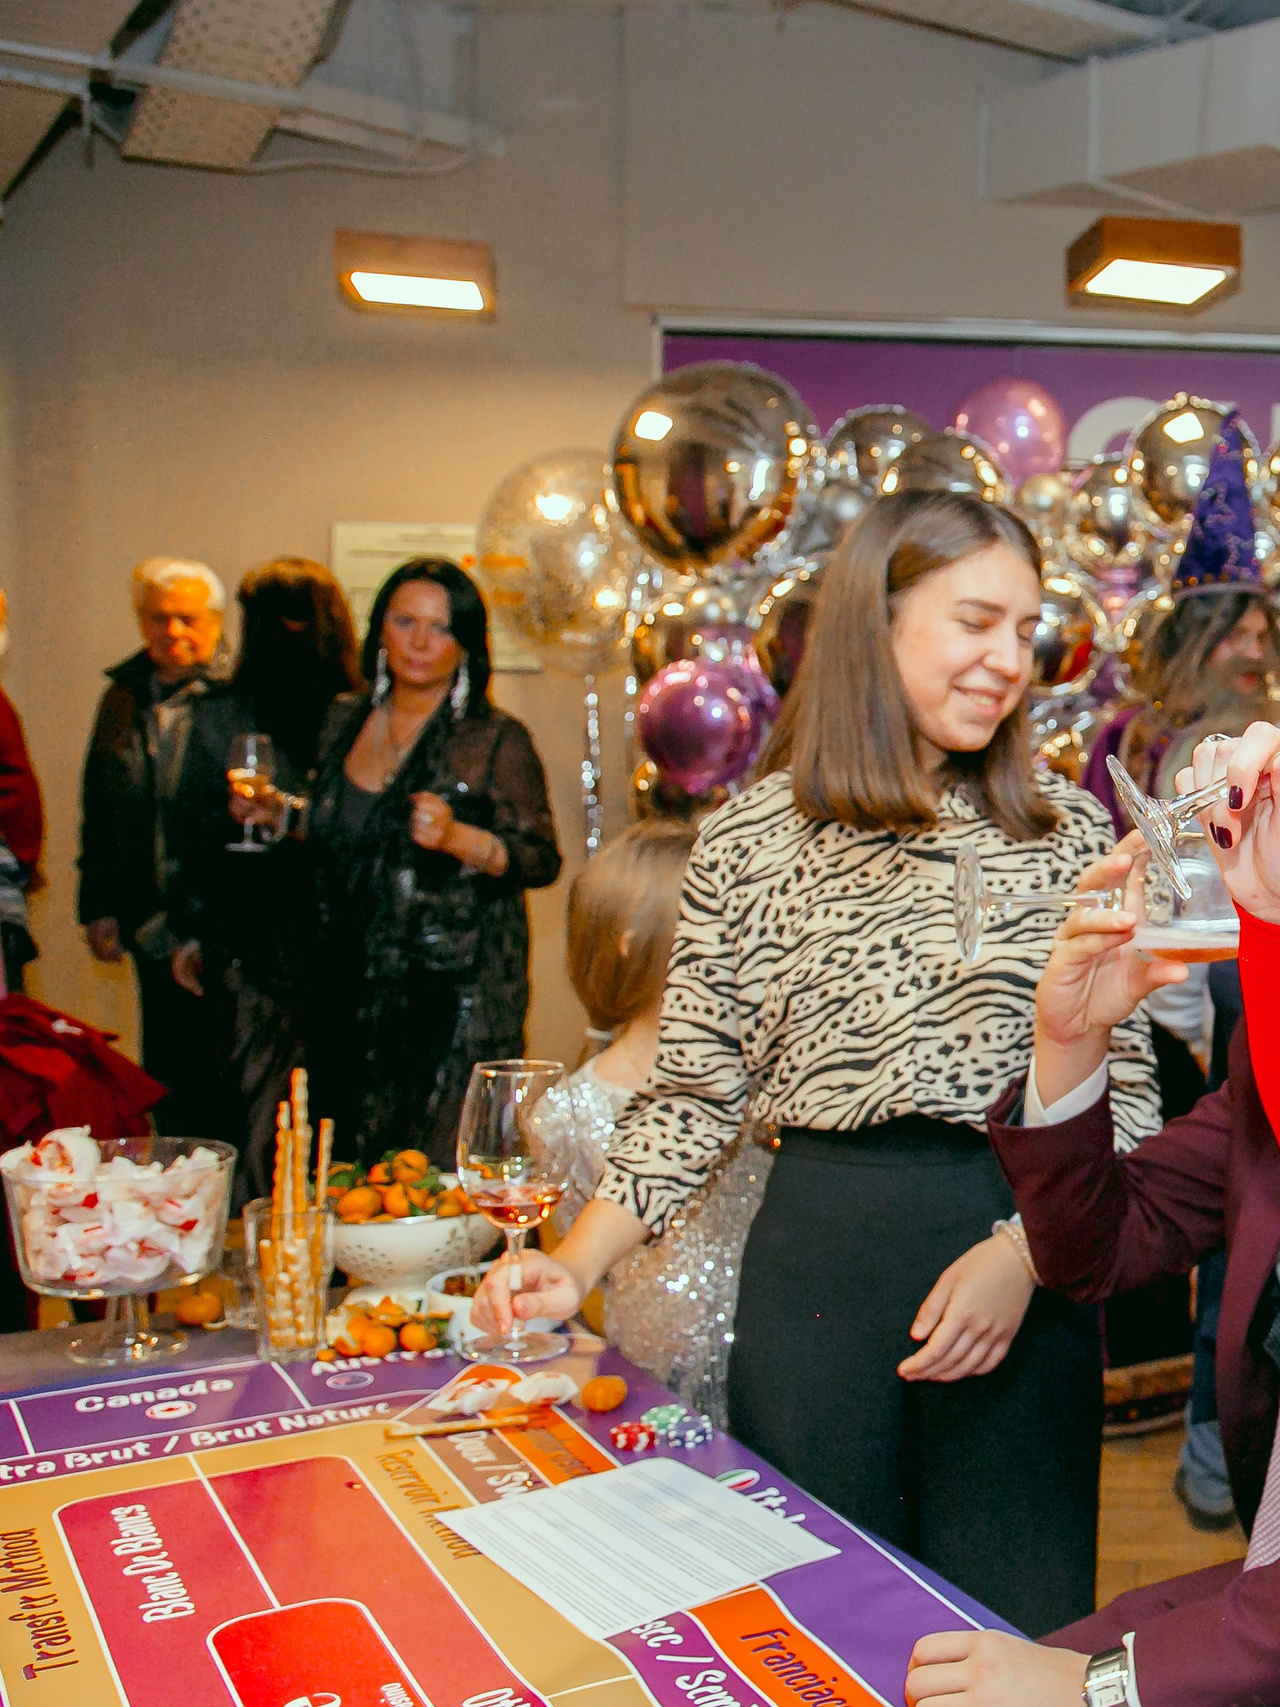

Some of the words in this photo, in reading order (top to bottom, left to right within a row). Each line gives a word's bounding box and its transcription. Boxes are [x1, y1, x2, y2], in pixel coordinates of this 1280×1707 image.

[74, 1379, 234, 1413] Canada
[64, 1441, 151, 1469] Brut
[190, 1420, 273, 1447] Brut
[277, 1402, 390, 1431] Nature
[109, 1503, 163, 1556] Blancs
[0, 1527, 52, 1593] Method
[122, 1551, 174, 1576] De
[138, 1571, 196, 1623] Blanc
[8, 1593, 80, 1681] Transfer
